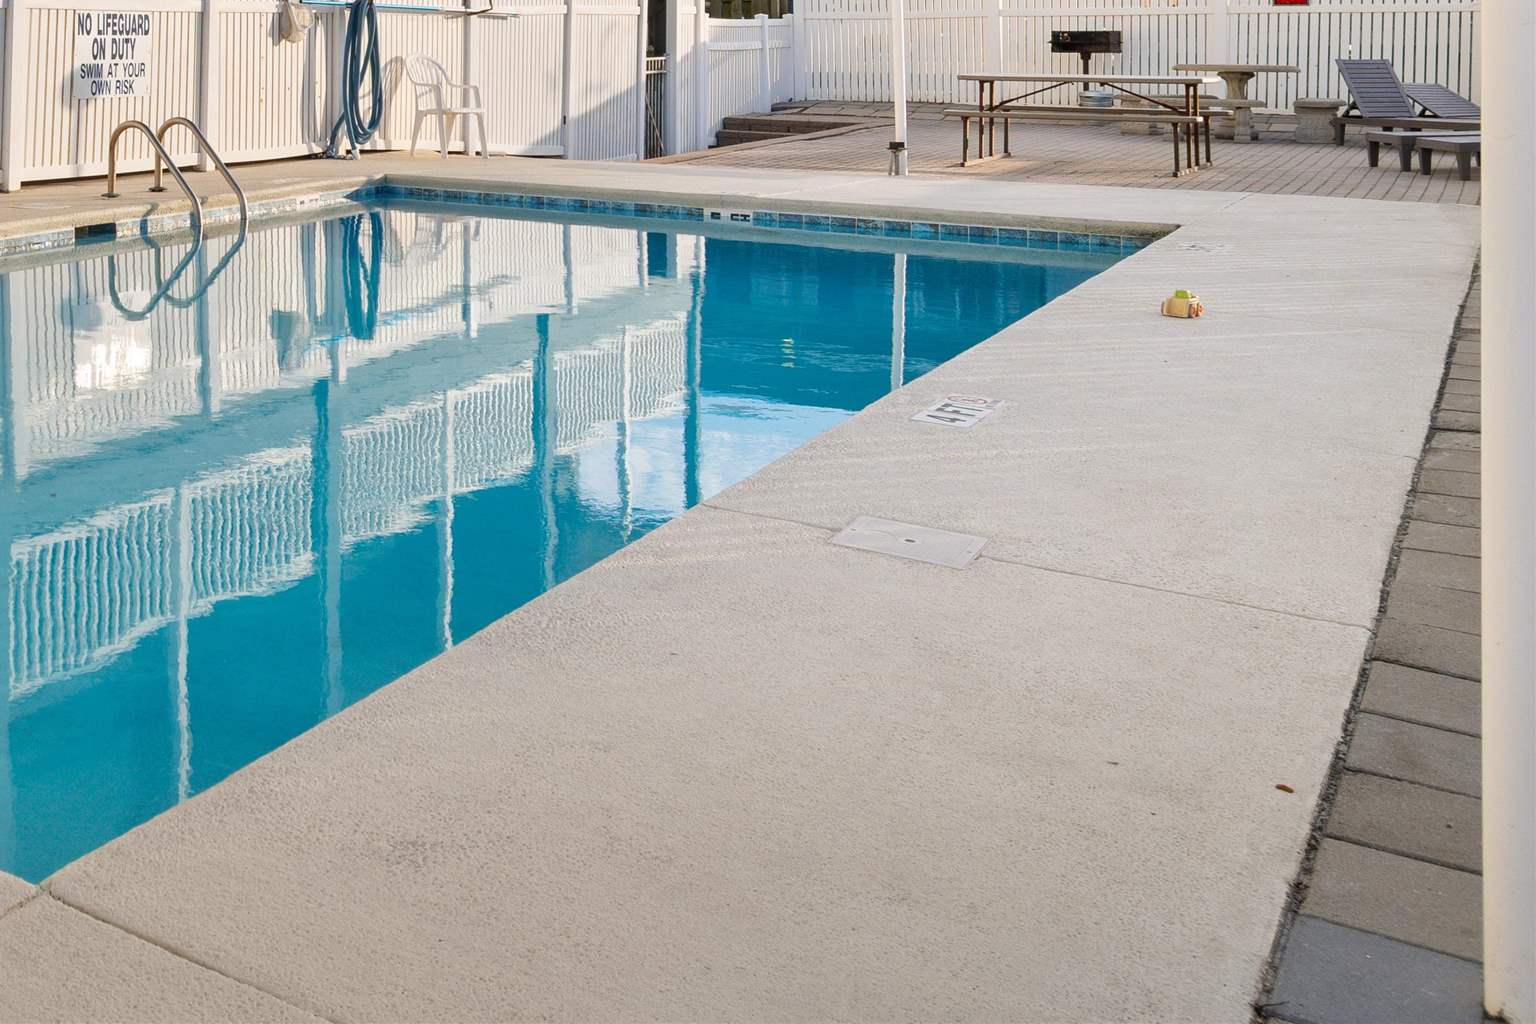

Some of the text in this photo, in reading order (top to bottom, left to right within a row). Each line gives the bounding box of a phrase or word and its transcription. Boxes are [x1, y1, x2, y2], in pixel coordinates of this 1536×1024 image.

[77, 12, 150, 36] NO LIFEGUARD
[92, 37, 136, 61] ON DUTY
[80, 62, 146, 79] SWIM AT YOUR
[90, 79, 135, 96] OWN RISK
[935, 403, 985, 417] FT
